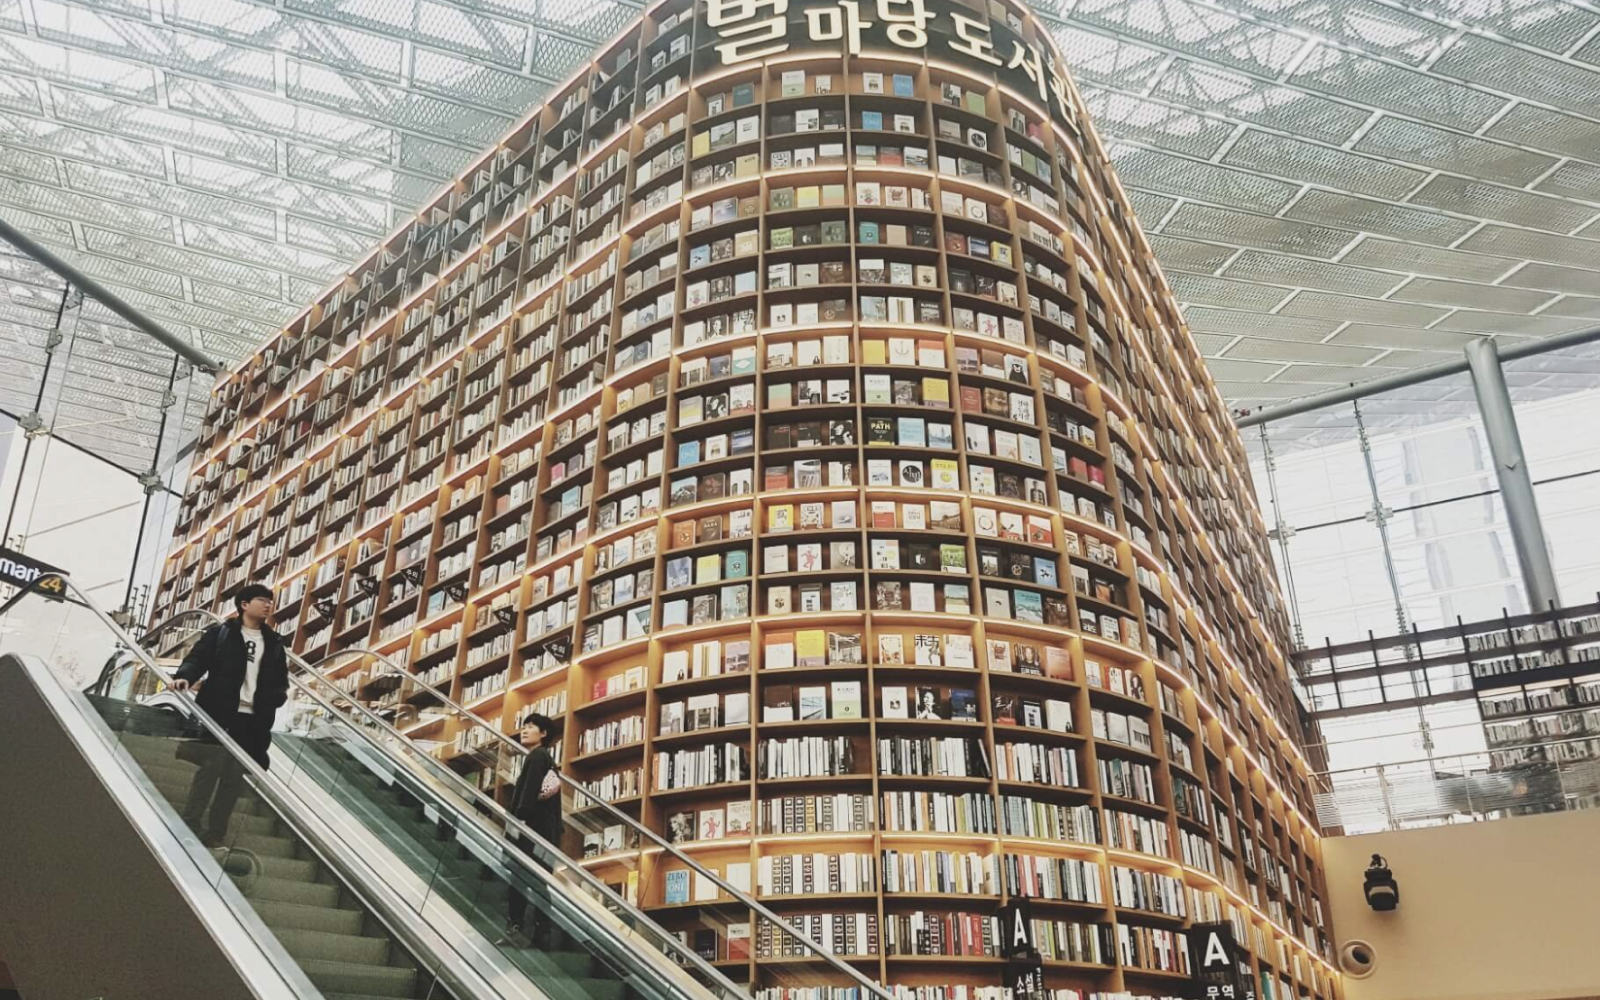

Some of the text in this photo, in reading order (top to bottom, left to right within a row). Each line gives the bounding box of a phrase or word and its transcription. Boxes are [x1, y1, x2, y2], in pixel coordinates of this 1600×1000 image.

[551, 643, 566, 654] 주의
[667, 872, 687, 881] ZERO
[1013, 908, 1028, 947] A
[1204, 931, 1231, 967] A
[1016, 972, 1035, 994] 소설
[1206, 984, 1235, 1000] 무역
